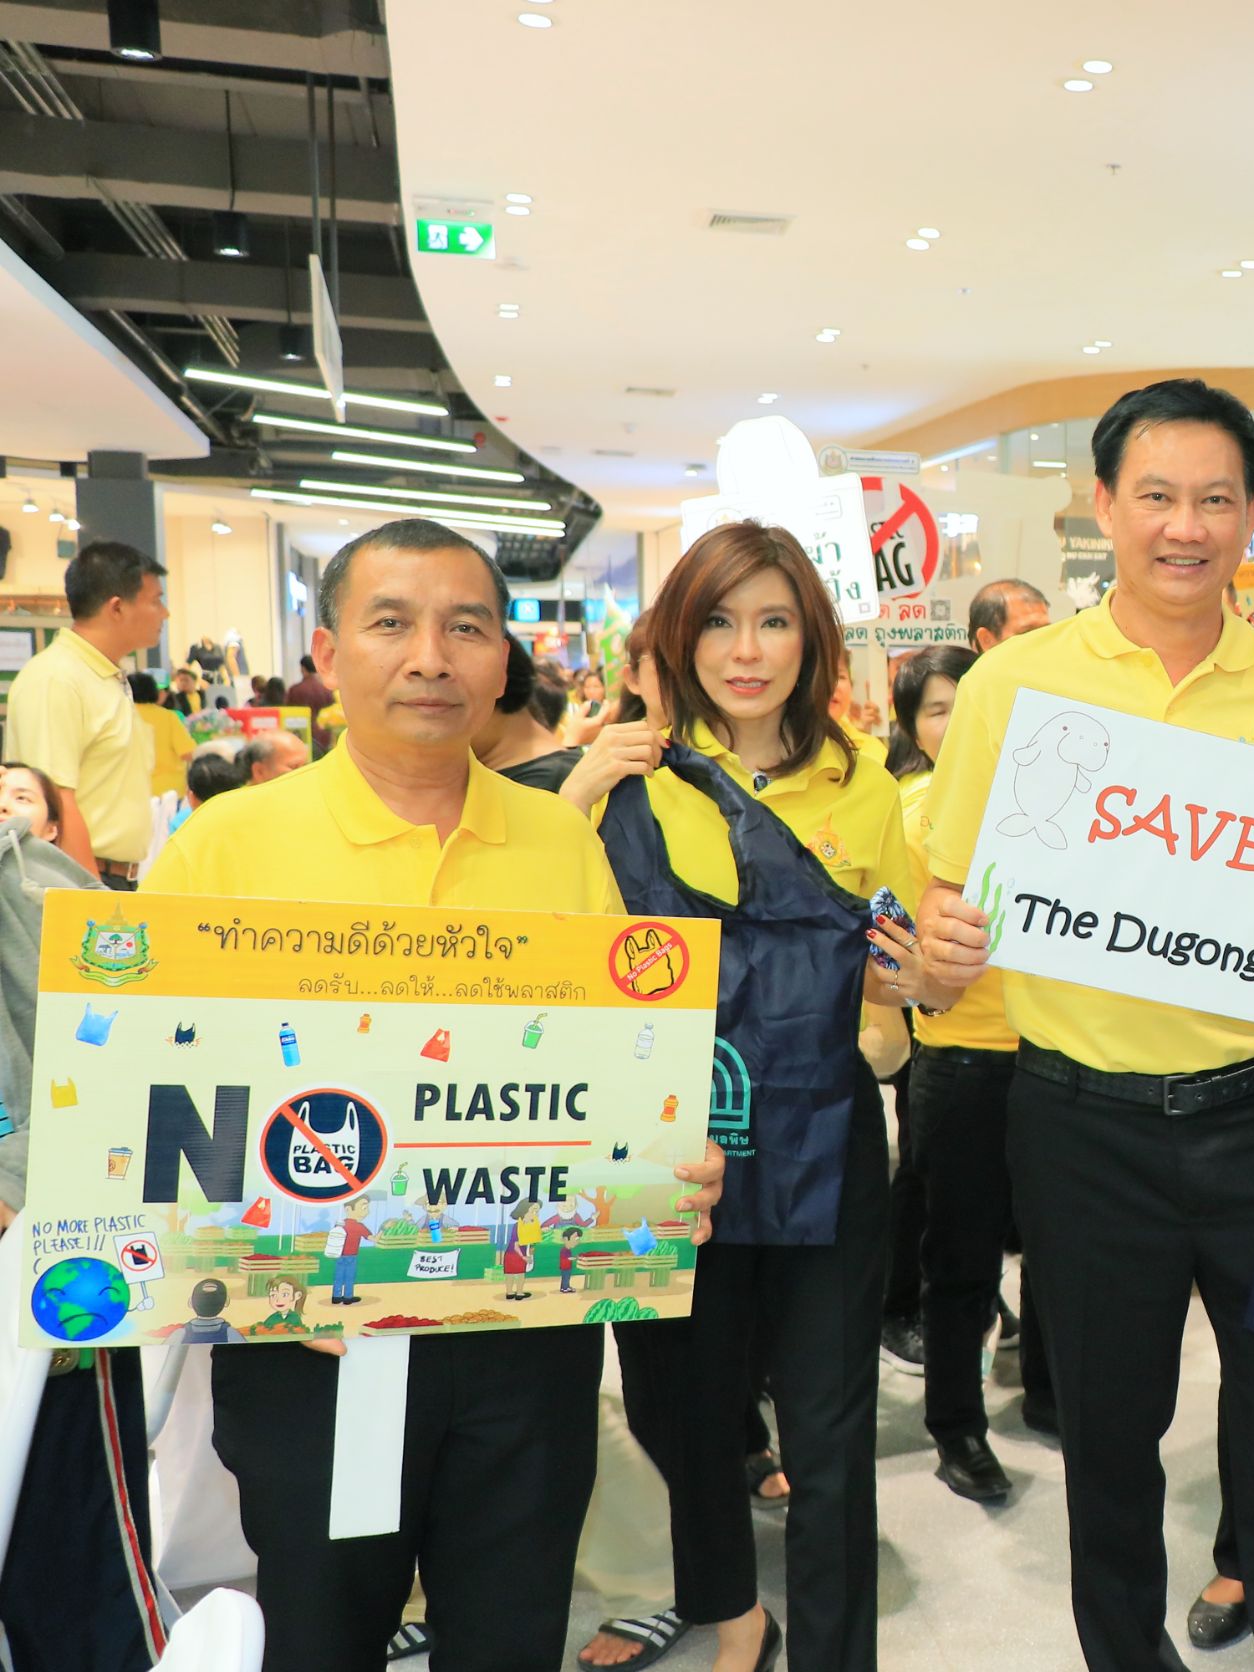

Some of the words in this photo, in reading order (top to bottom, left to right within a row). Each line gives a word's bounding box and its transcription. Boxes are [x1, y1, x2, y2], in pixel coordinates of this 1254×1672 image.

[1015, 893, 1099, 939] The
[636, 955, 658, 973] Plastic
[656, 942, 673, 957] Bags
[414, 1082, 589, 1122] PLASTIC
[293, 1155, 354, 1175] BAG
[422, 1165, 569, 1206] WASTE
[32, 1221, 52, 1238] NO
[57, 1218, 89, 1236] MORE
[94, 1214, 146, 1233] PLASTIC
[420, 1255, 443, 1264] BEST
